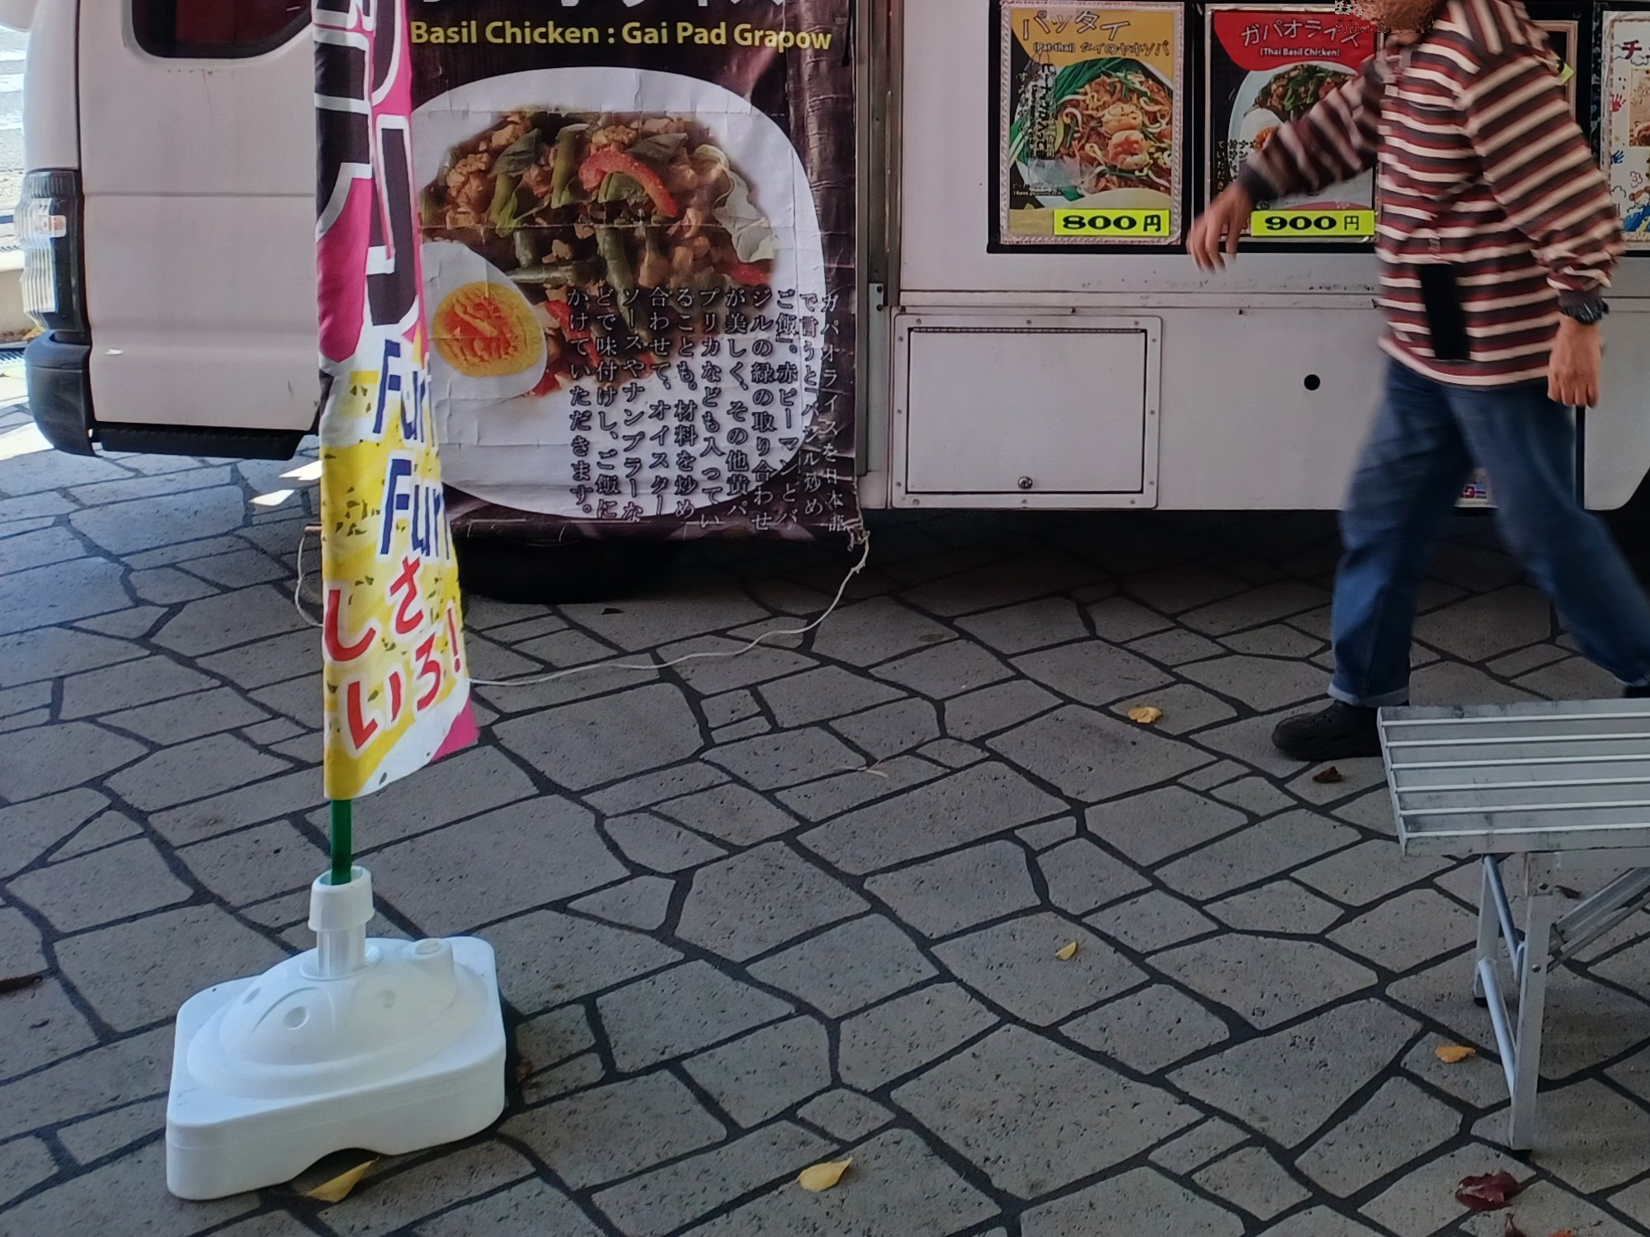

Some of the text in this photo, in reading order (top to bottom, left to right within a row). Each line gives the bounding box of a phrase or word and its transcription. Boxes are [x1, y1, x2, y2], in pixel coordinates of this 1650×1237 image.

[410, 20, 478, 46] Basil
[485, 20, 600, 47] Chicken
[622, 21, 669, 47] Gai
[676, 21, 727, 48] Pad
[733, 23, 833, 53] Grapow
[1022, 8, 1131, 41] パッタイ
[1241, 19, 1362, 48] ガパオライス
[1283, 48, 1303, 57] Basil
[568, 288, 594, 514] かけていただきます。
[595, 287, 620, 520] どで味付けし、ご飯に
[622, 288, 645, 522] ソースやナンプラーな
[649, 287, 671, 516] 合わせて、オイスター
[674, 288, 698, 518] ることも。材料を炒め
[700, 289, 726, 529] プリカなども入ってい
[751, 288, 777, 531] ジルの緑の取り合わせ
